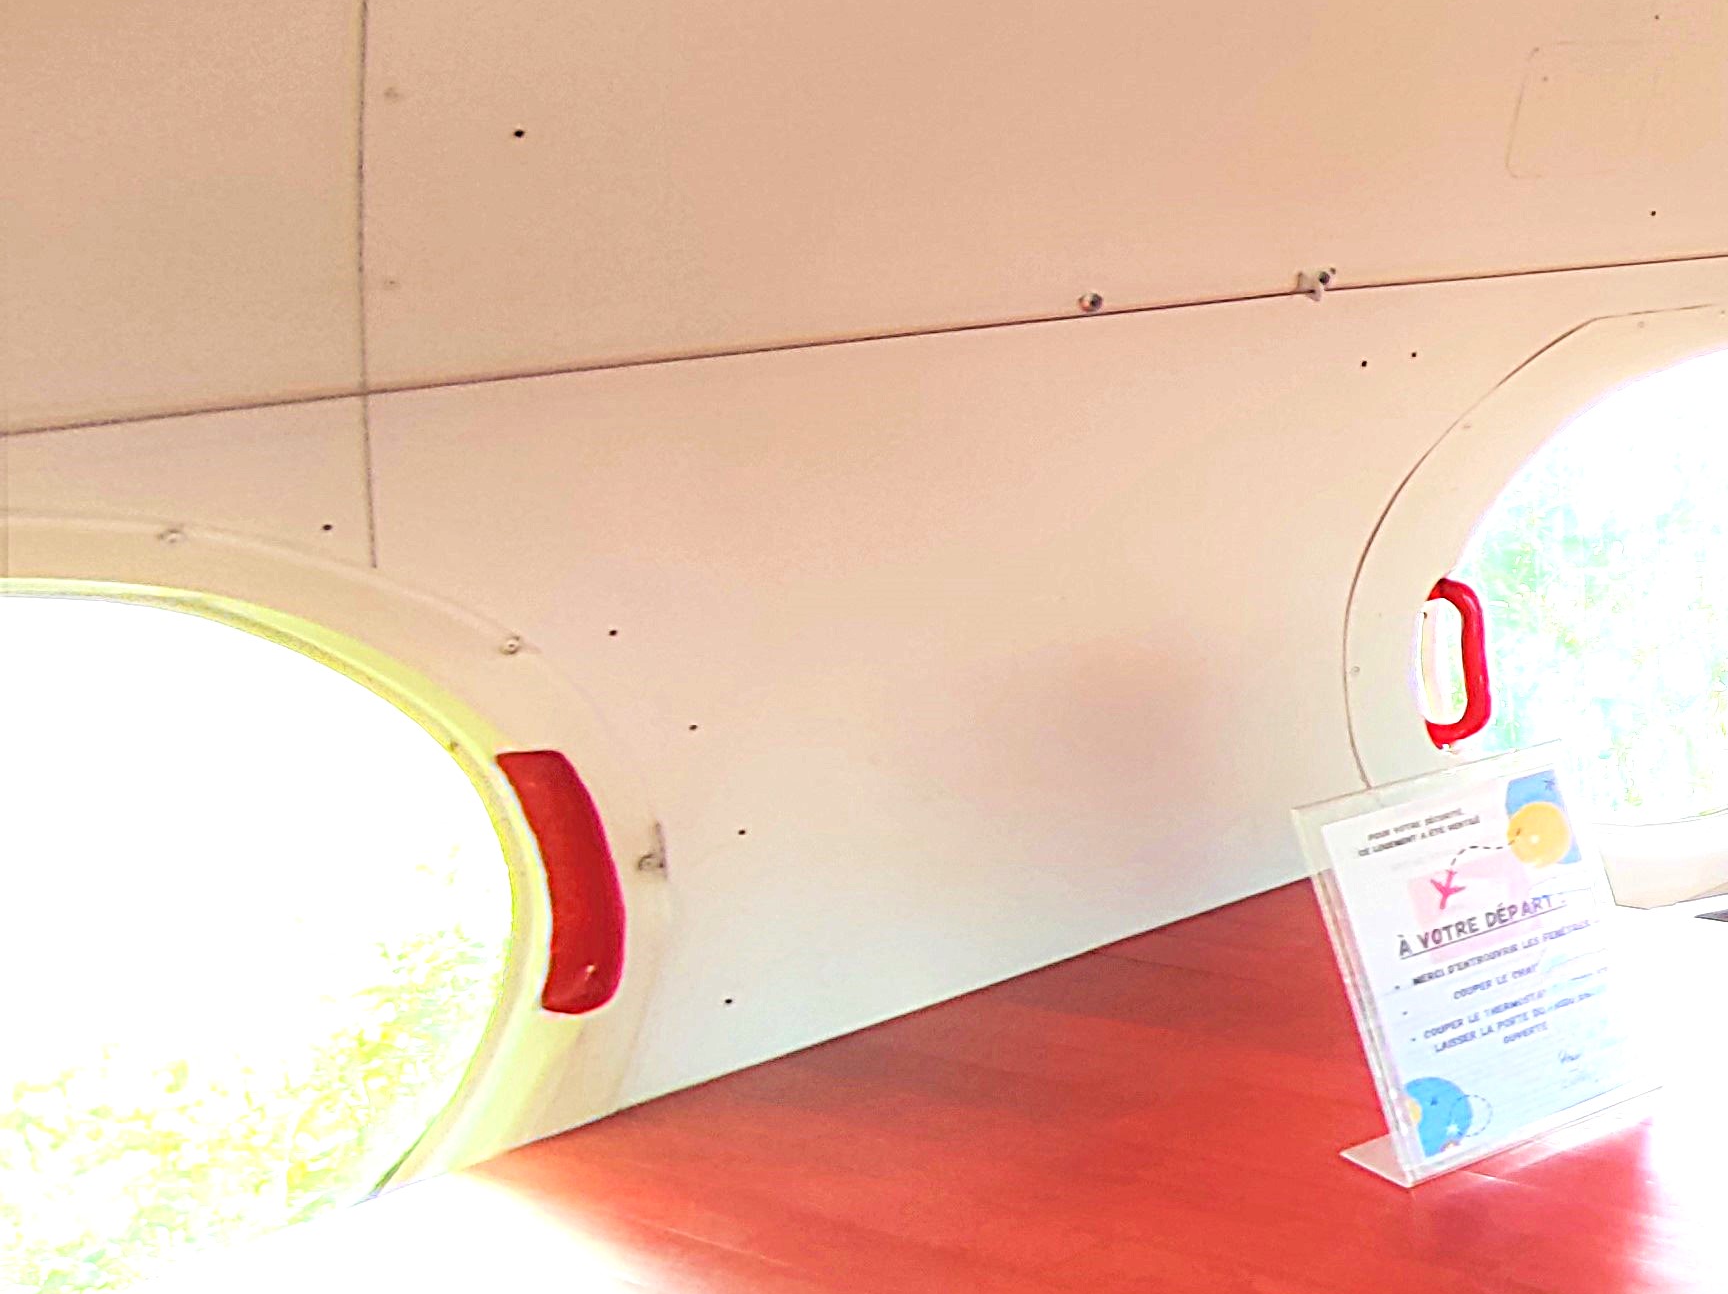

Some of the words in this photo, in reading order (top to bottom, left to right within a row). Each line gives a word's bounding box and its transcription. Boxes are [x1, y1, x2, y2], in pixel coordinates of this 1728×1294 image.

[1397, 934, 1412, 956] À
[1417, 917, 1479, 949] VOTRE
[1485, 895, 1552, 927] DÉPART
[1413, 969, 1445, 985] MERCI
[1522, 937, 1539, 949] LES
[1454, 980, 1492, 999] COUPER
[1496, 974, 1508, 984] LE
[1424, 1019, 1463, 1038] COUPER
[1468, 1012, 1480, 1023] LE
[1434, 1031, 1476, 1052] LAISSER
[1480, 1025, 1493, 1036] LA
[1497, 1012, 1528, 1029] PORTE
[1504, 1021, 1547, 1043] OUVERTE
